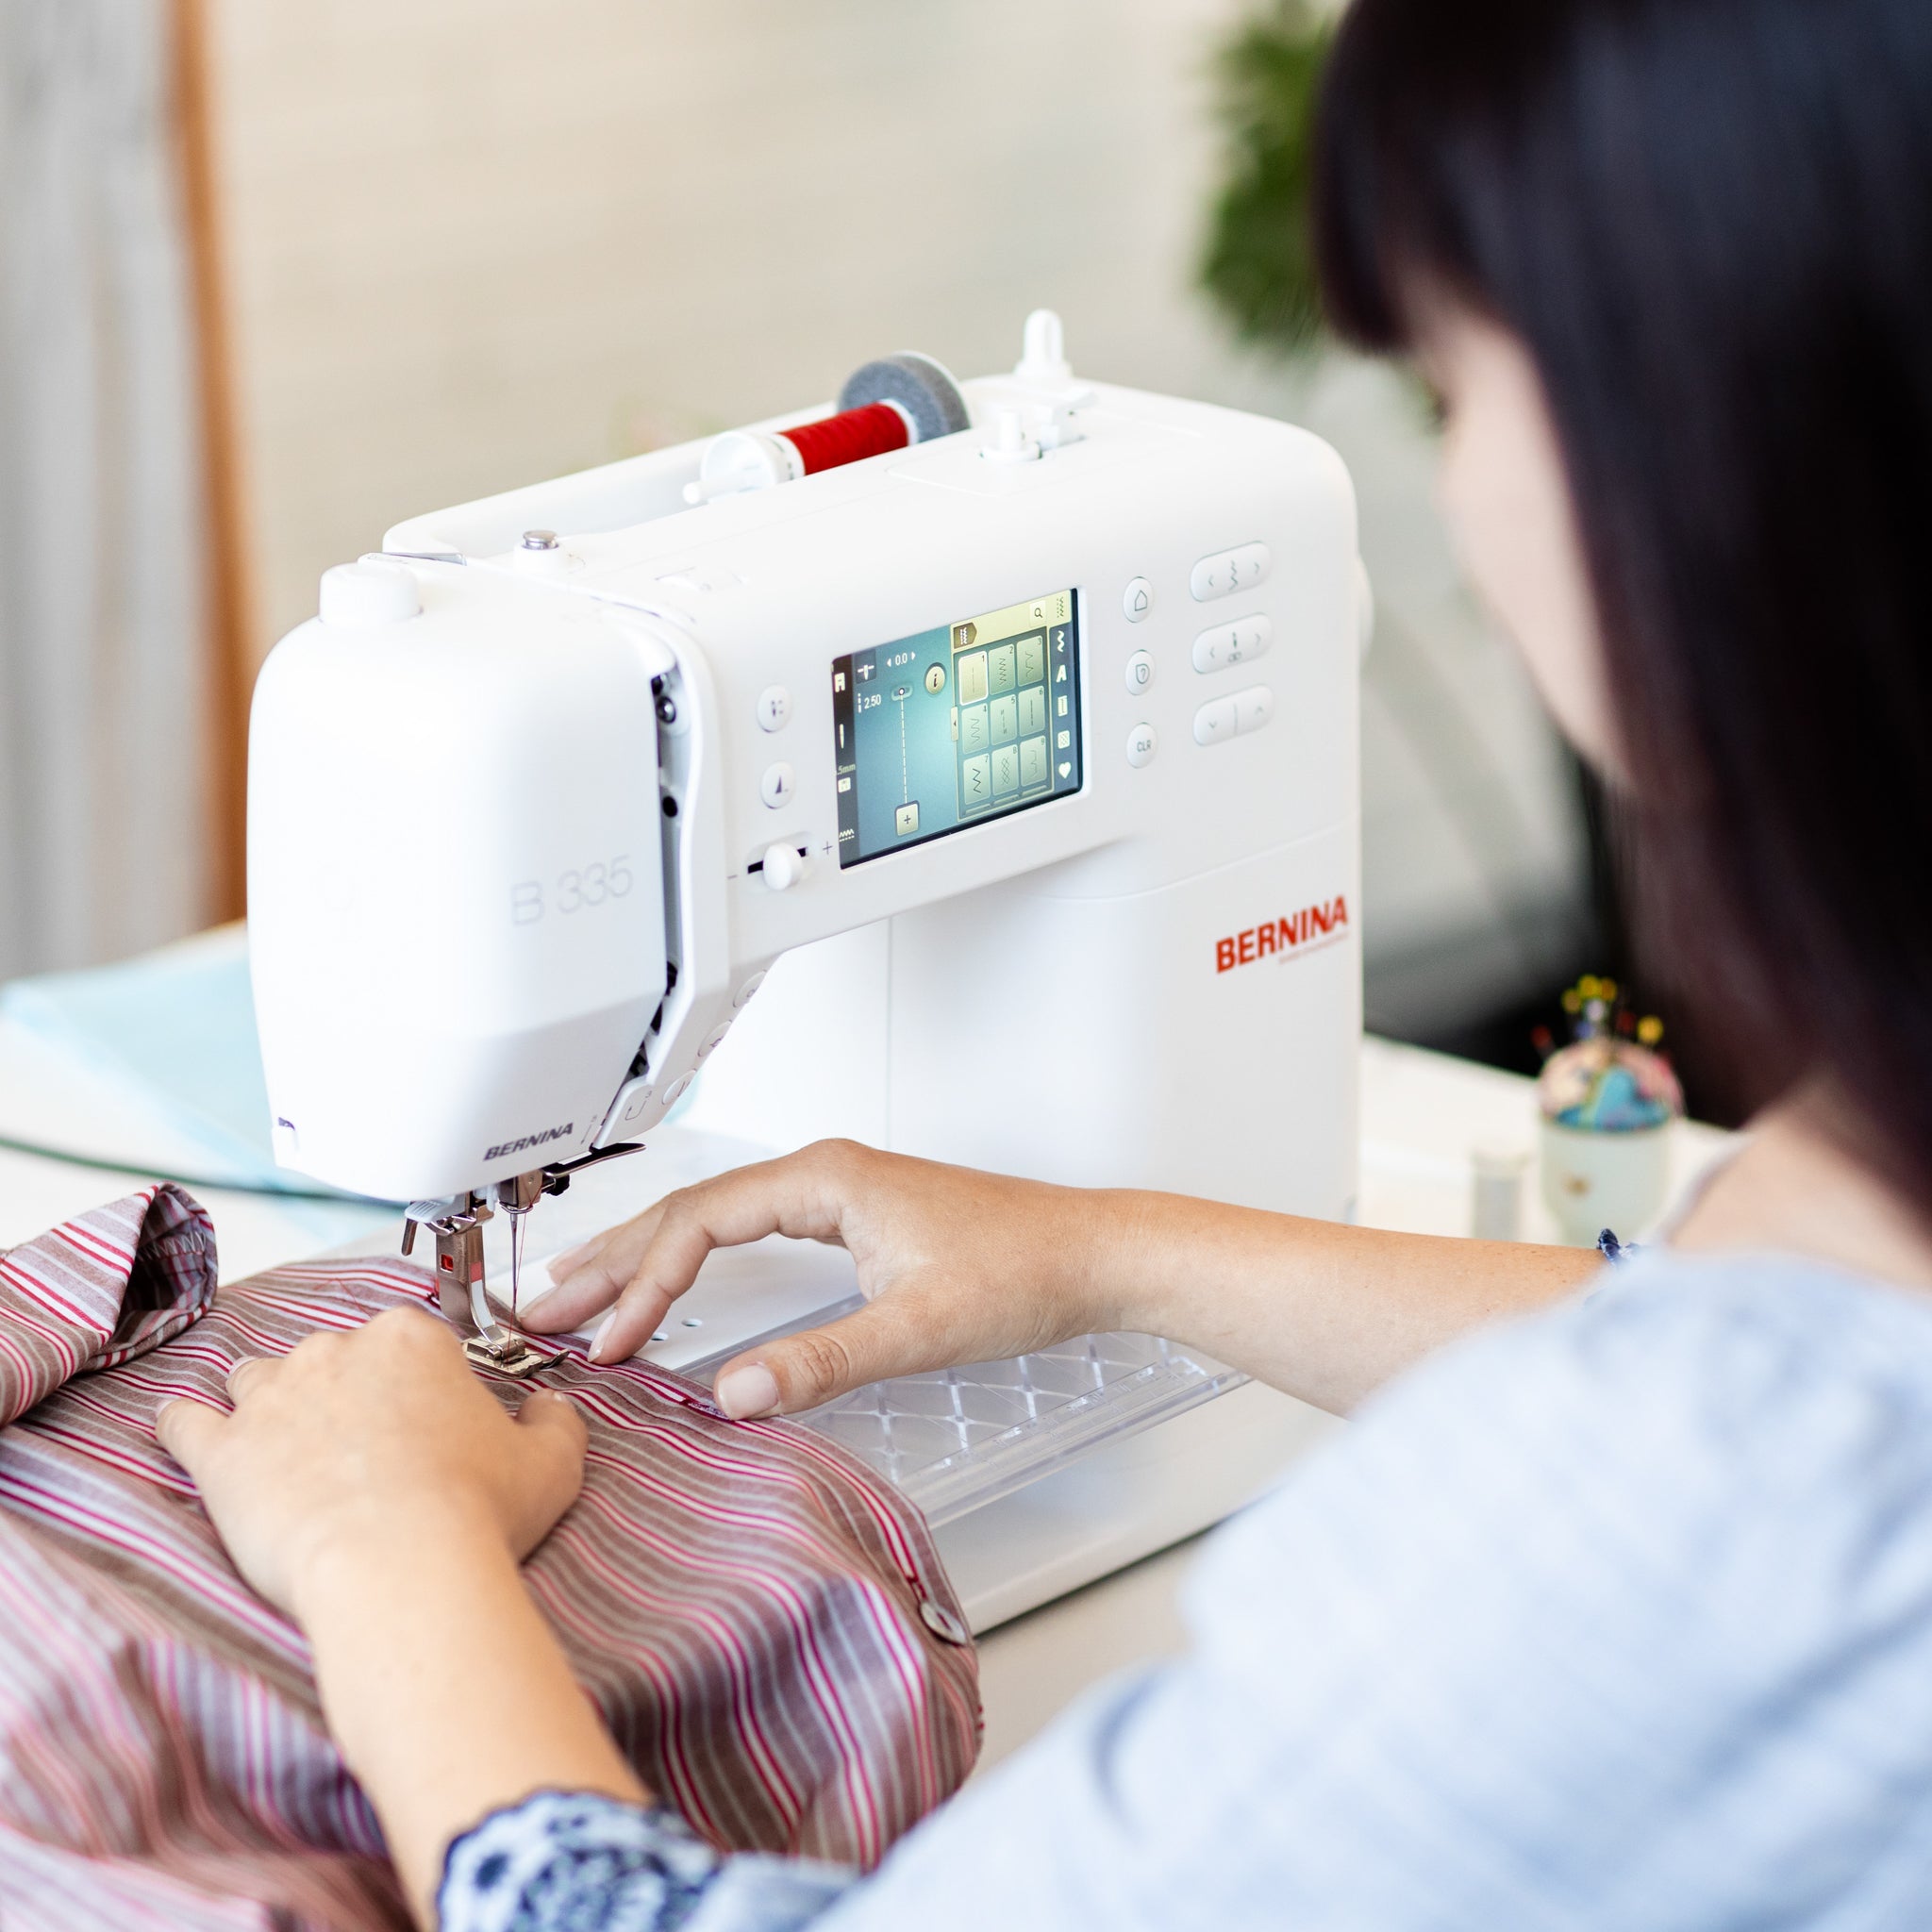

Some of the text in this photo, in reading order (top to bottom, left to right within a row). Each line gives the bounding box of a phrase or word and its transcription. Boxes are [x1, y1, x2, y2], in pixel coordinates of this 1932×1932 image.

[894, 653, 908, 666] 0.0
[863, 693, 882, 709] 2.50
[1136, 739, 1152, 753] CLR
[837, 763, 857, 775] .5mm
[511, 853, 634, 927] B 335
[1216, 894, 1347, 974] BERNINA
[483, 1123, 574, 1160] BERNINA
